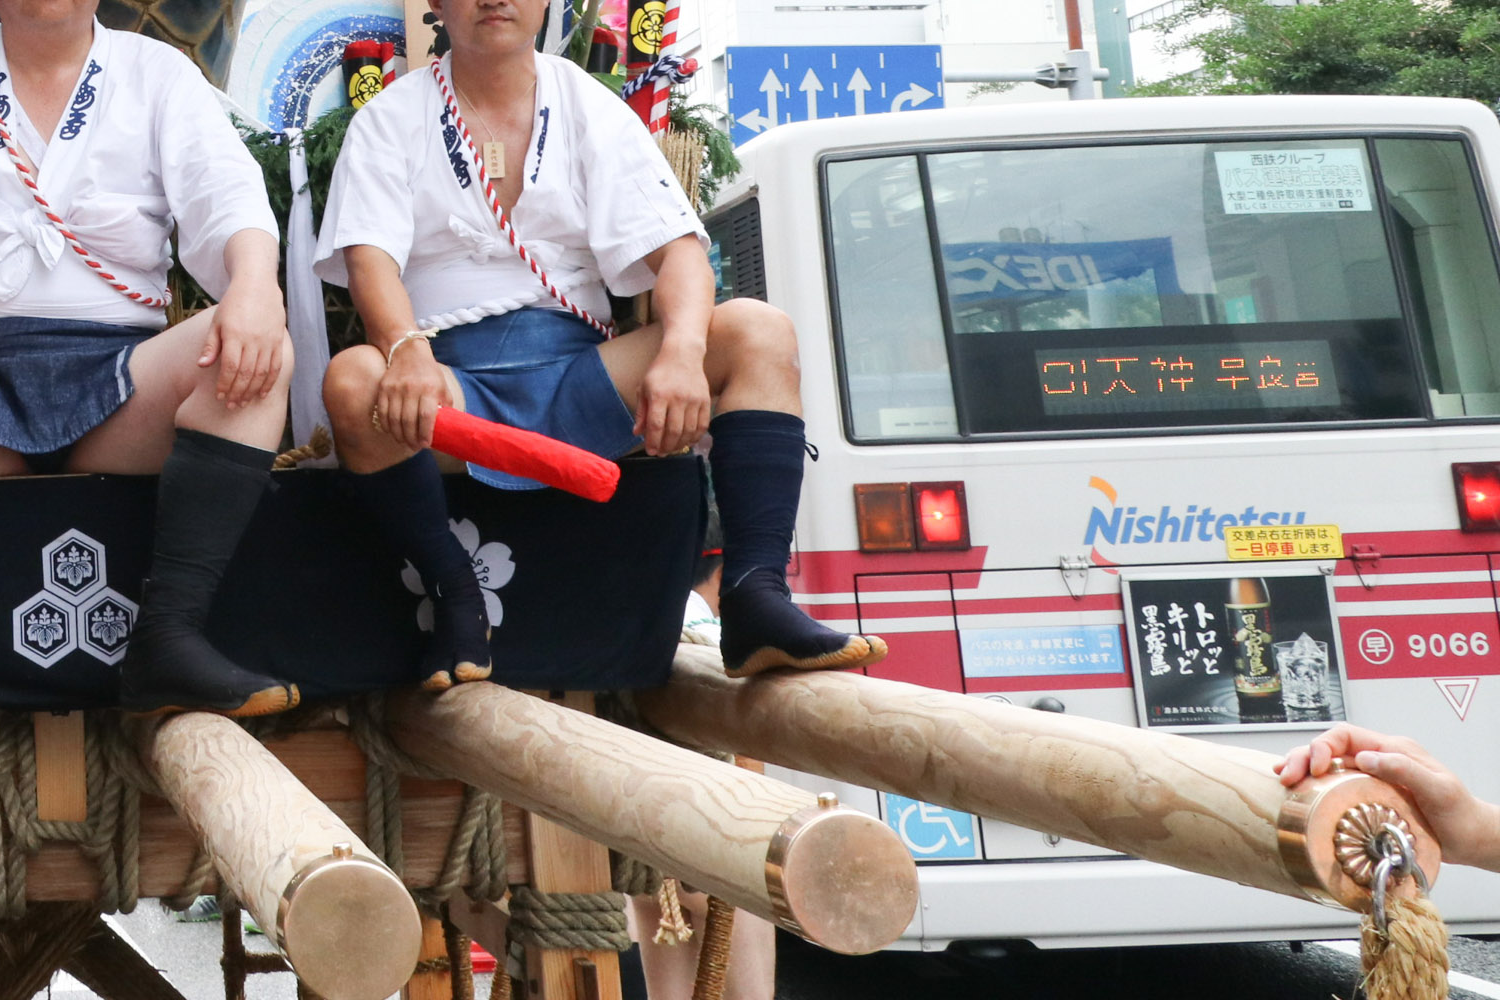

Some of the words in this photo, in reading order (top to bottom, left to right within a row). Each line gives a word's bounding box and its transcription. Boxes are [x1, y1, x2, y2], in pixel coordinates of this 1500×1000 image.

[1251, 152, 1326, 166] 西鉄グループ
[1224, 165, 1363, 188] バス運転士募集
[1363, 633, 1391, 660] 早
[1408, 632, 1490, 658] 9066
